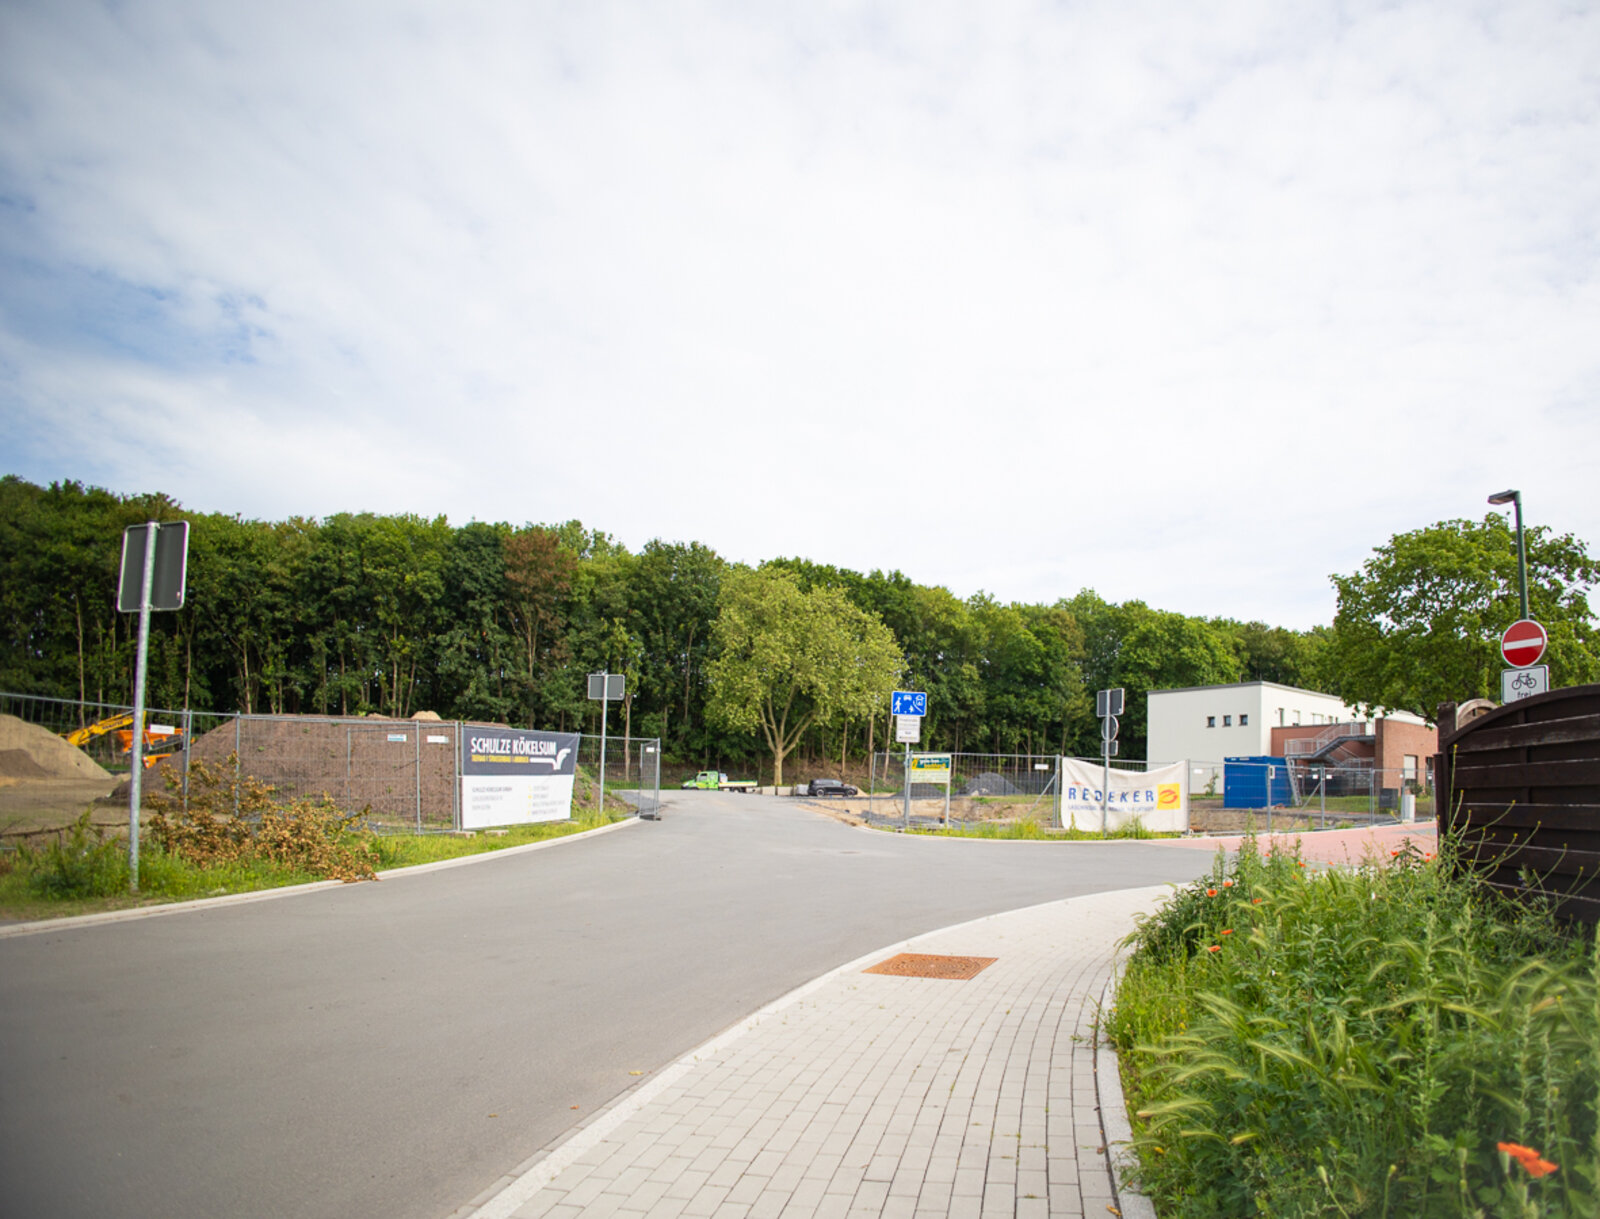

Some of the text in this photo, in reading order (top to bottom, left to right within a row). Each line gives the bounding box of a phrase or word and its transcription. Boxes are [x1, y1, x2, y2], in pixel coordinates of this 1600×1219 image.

[471, 737, 556, 755] SCHULZE KÖKELSUM
[1068, 787, 1154, 802] REDEKER
